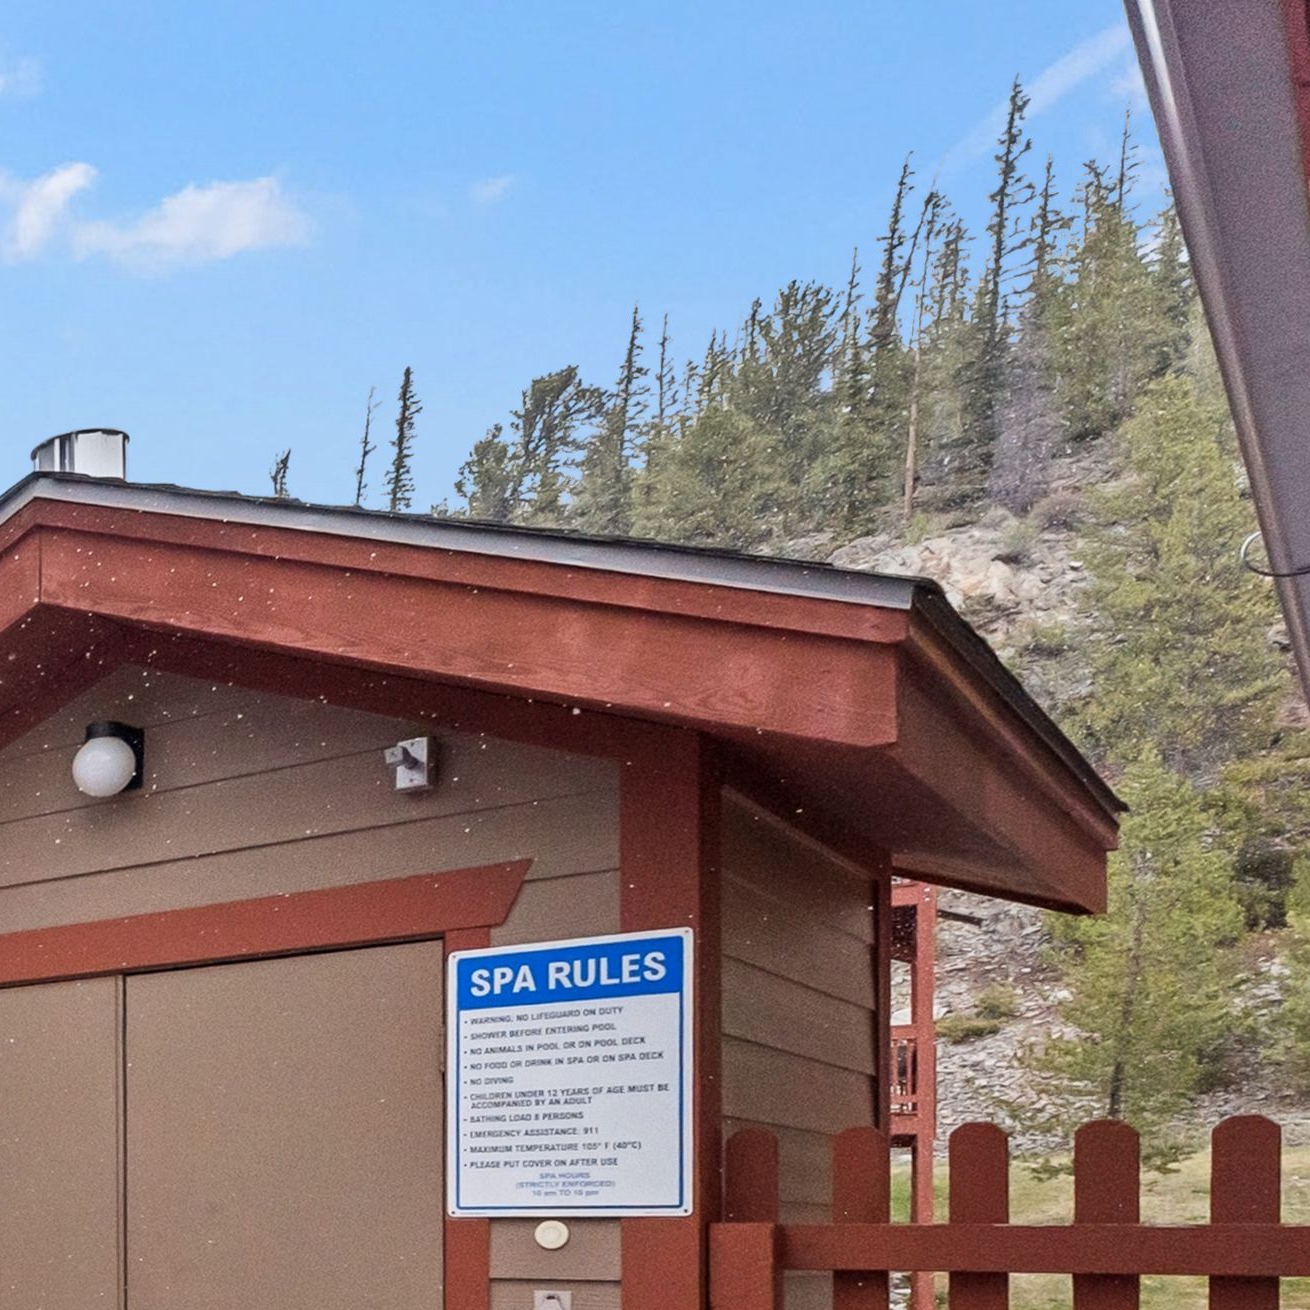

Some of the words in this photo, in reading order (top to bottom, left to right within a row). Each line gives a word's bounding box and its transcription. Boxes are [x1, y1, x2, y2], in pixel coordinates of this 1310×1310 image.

[470, 965, 536, 997] SPA
[548, 951, 667, 990] RULES
[531, 1010, 580, 1020] LIFEGUARD
[599, 1006, 624, 1015] DUTY
[470, 1031, 507, 1040] SHOWER
[509, 1028, 542, 1038] BEFORE
[545, 1024, 589, 1034] ENTERING
[592, 1023, 617, 1031] POOL
[484, 1045, 523, 1054] ANIMALS
[563, 1041, 575, 1049] OR
[578, 1040, 591, 1048] ON
[594, 1039, 618, 1047] POOL
[621, 1036, 646, 1045] DECK
[484, 1061, 508, 1069] FOOD
[525, 1059, 551, 1067] DRINK
[567, 1056, 584, 1065] SPA
[586, 1055, 599, 1063] OR
[602, 1054, 615, 1062] ON
[618, 1053, 636, 1062] SPA
[639, 1051, 664, 1060] DECK
[484, 1076, 514, 1085] DIVING
[470, 1092, 512, 1100] CHILDREN
[514, 1090, 544, 1098] UNDER
[547, 1089, 558, 1097] 12
[560, 1087, 589, 1096] YEARS
[592, 1086, 604, 1094] OF
[606, 1085, 625, 1094] AGE
[627, 1084, 654, 1093] MUST
[657, 1083, 670, 1091] BE
[471, 1100, 532, 1109] ACCOMPANIED
[563, 1096, 592, 1105] ADULT
[470, 1114, 507, 1123] BATHING
[509, 1113, 532, 1121] LOAD
[542, 1111, 584, 1120] PERSONS
[470, 1129, 521, 1138] EMERGENCY
[583, 1127, 599, 1135] 911
[470, 1145, 512, 1153] MAXIMUM
[515, 1143, 578, 1152] TEMPERATURE
[503, 1160, 519, 1168] PUT
[554, 1159, 567, 1167] ON
[569, 1158, 598, 1166] AFTER
[600, 1158, 618, 1166] USE
